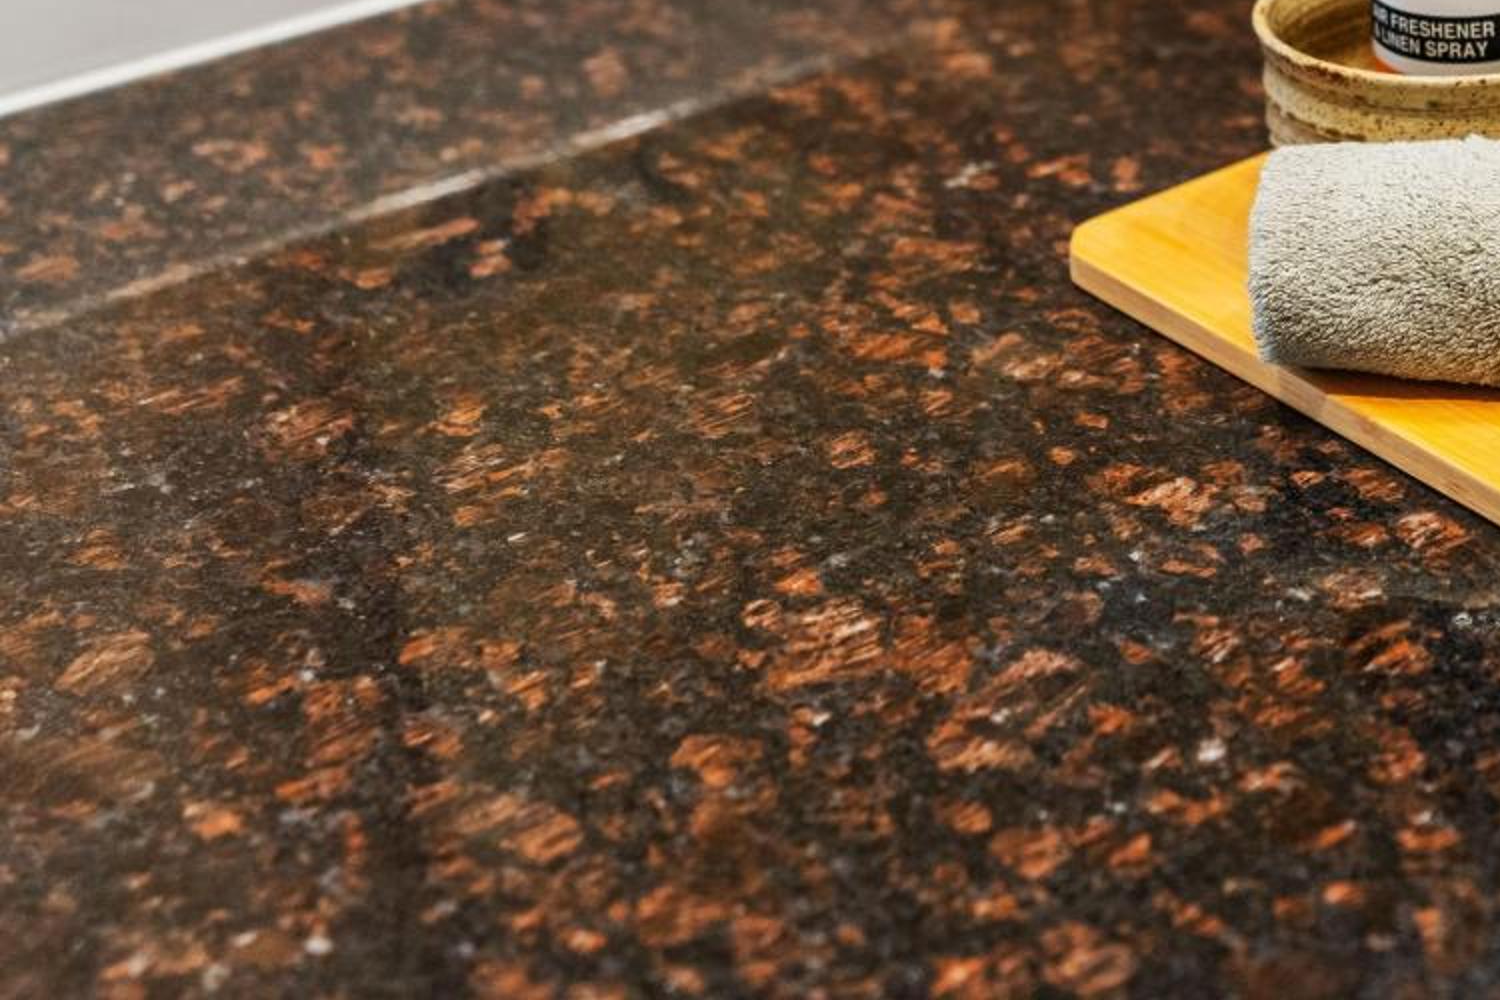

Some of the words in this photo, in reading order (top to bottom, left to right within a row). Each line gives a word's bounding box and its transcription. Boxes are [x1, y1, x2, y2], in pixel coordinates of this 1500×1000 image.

[1391, 13, 1496, 39] FRESHENER
[1381, 28, 1421, 55] LINEN
[1425, 40, 1489, 59] SPRAY
